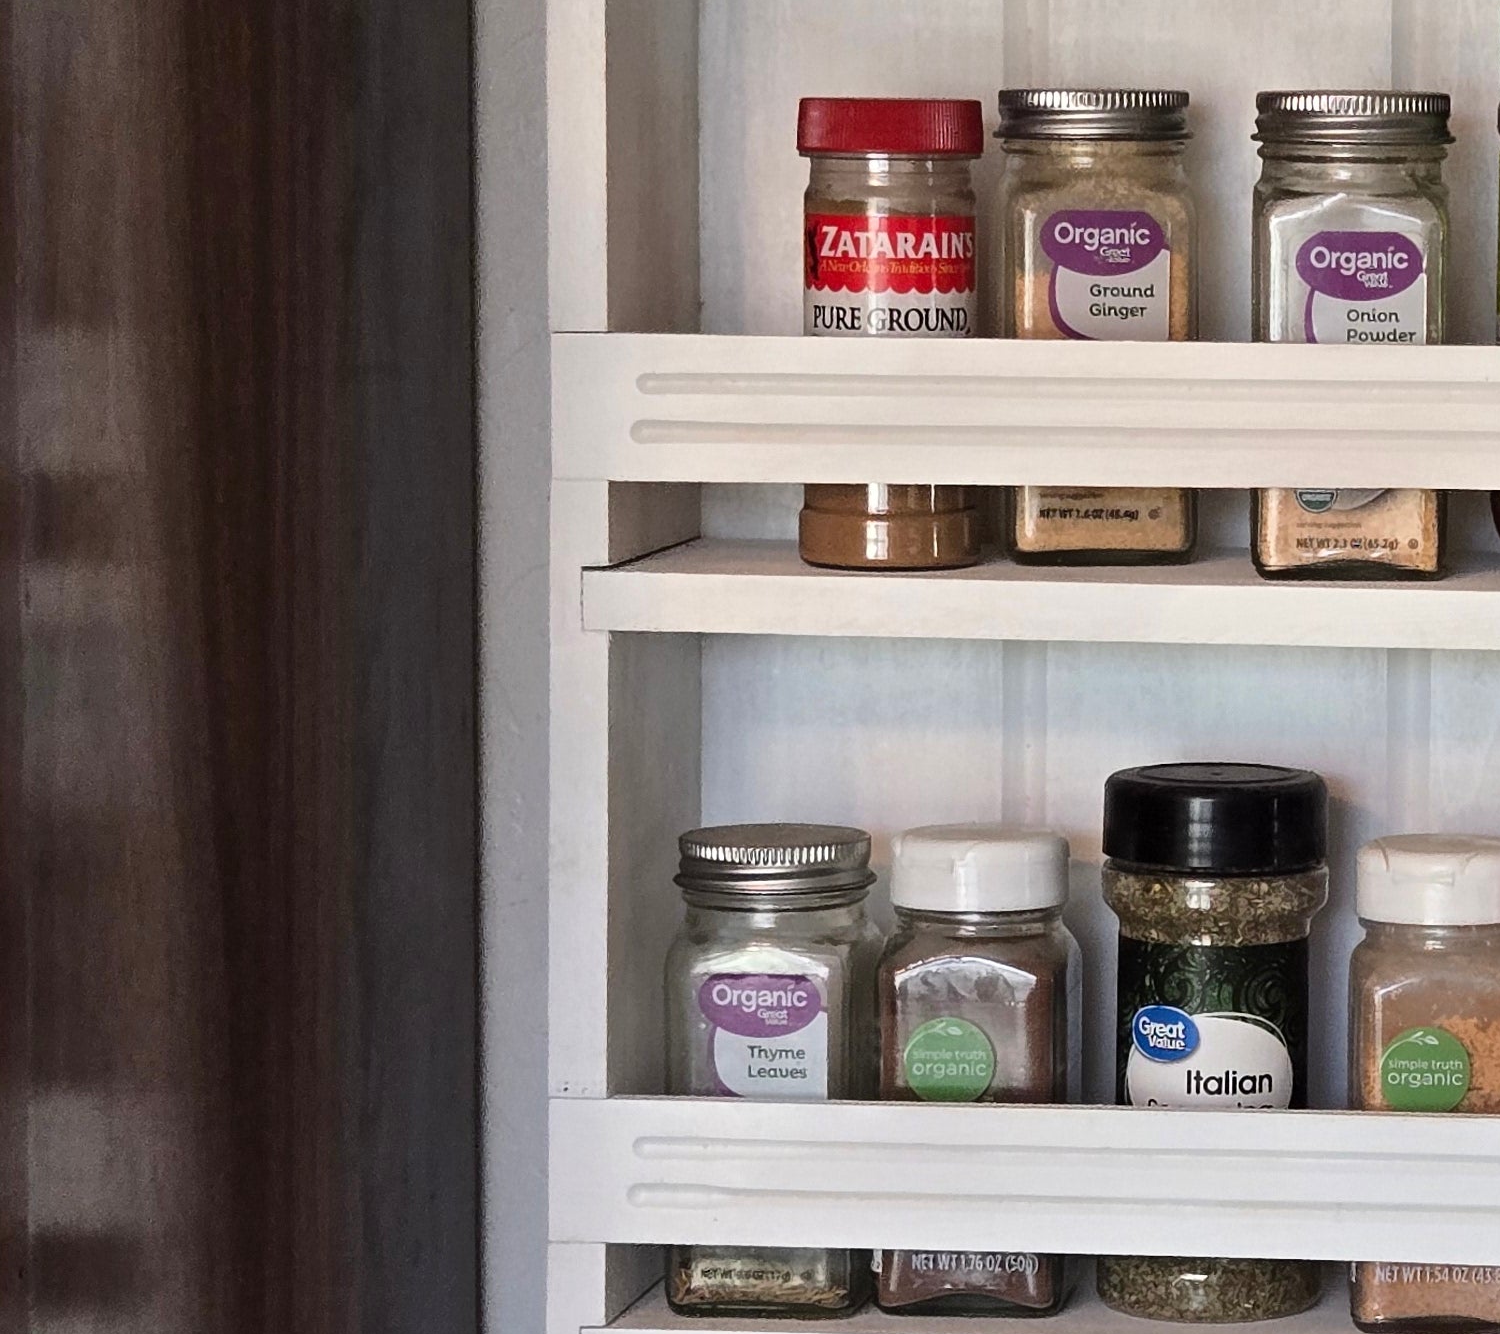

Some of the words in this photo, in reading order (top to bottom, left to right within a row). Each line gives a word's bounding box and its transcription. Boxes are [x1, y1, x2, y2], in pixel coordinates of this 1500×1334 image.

[820, 225, 973, 259] ZATARAIN'S
[1054, 221, 1151, 251] Organic
[1310, 246, 1409, 276] Organic
[1089, 283, 1155, 298] Ground
[813, 304, 862, 330] PURE
[1089, 303, 1147, 319] Ginger
[1346, 308, 1400, 323] Onion
[1346, 328, 1417, 343] Powder
[712, 984, 808, 1013] Organic
[1139, 1017, 1185, 1039] Great
[1149, 1036, 1185, 1050] Value
[747, 1045, 806, 1062] Thyme
[955, 1049, 987, 1060] truth
[747, 1065, 807, 1079] Leaves
[912, 1061, 987, 1079] organic
[1388, 1059, 1428, 1071] simple
[1431, 1059, 1463, 1070] truth
[1187, 1070, 1273, 1096] Italian
[1387, 1072, 1463, 1088] organic
[911, 1253, 934, 1271] NET
[937, 1254, 957, 1271] WT
[959, 1254, 983, 1271] 1.76
[986, 1255, 1002, 1272] OZ
[1375, 1265, 1399, 1284] NET
[1402, 1267, 1423, 1284] WT
[1424, 1267, 1449, 1284] 1.54
[1452, 1268, 1470, 1285] OZ
